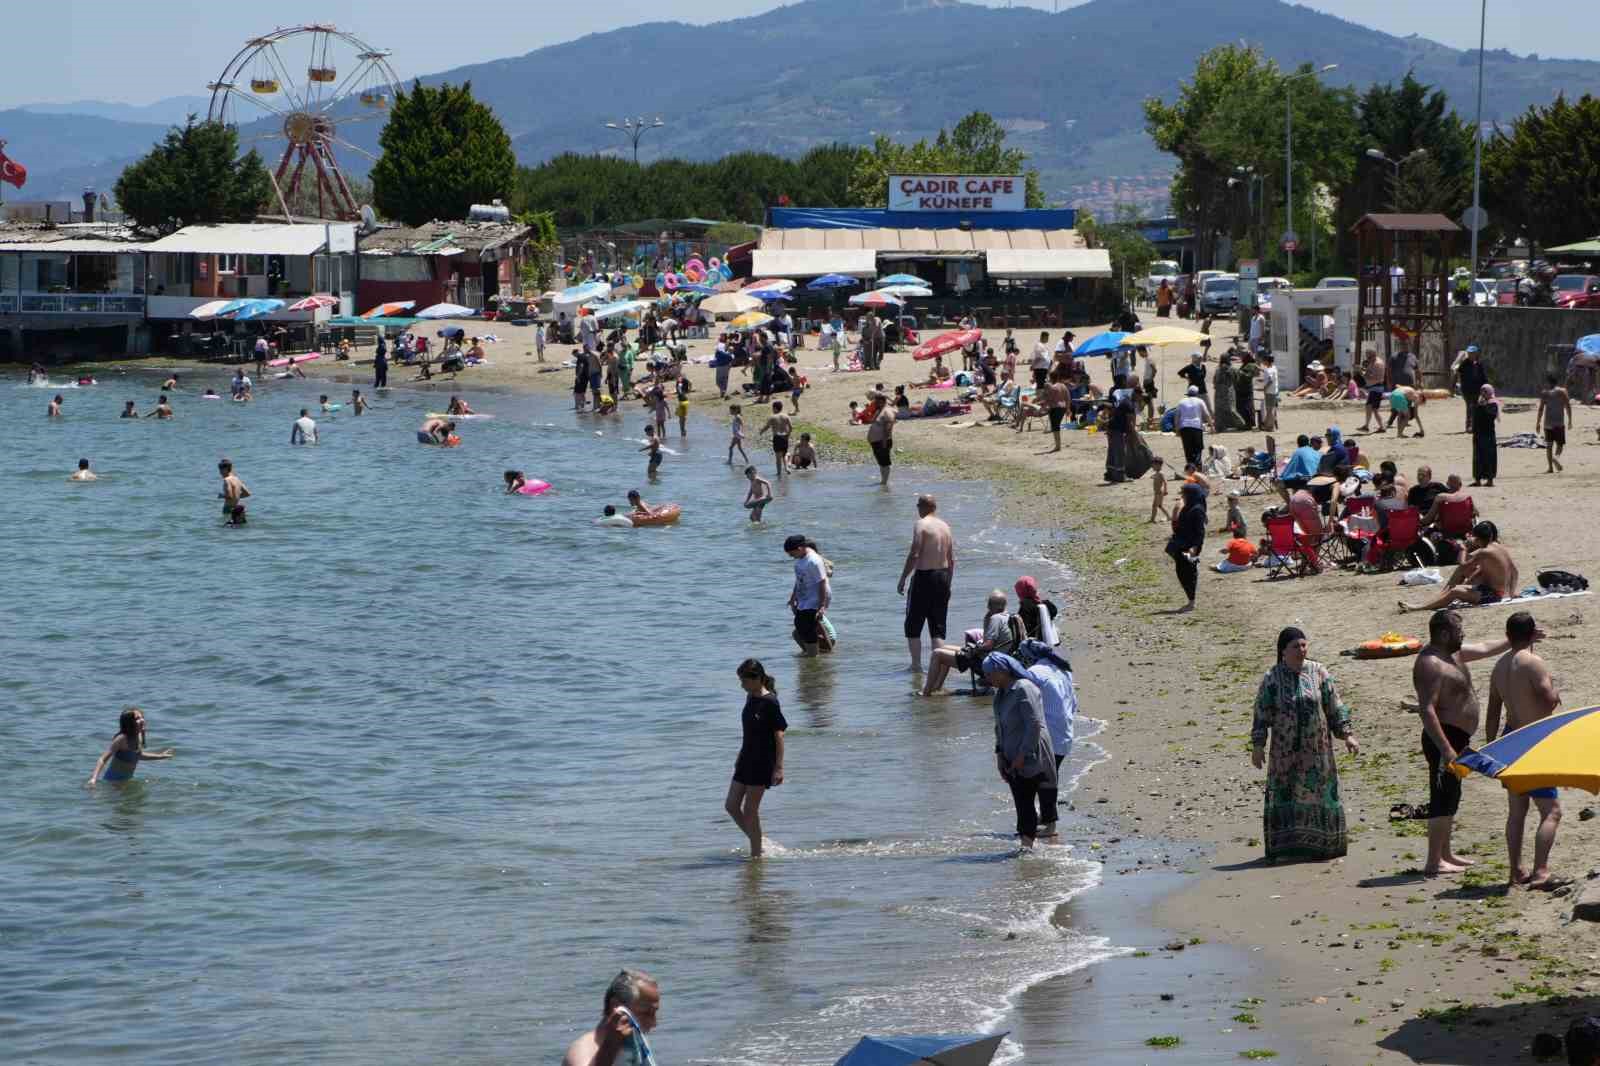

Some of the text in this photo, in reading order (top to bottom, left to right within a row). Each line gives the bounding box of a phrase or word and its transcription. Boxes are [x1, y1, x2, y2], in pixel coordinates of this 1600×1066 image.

[901, 180, 1014, 197] ÇADIR CAFE
[919, 195, 993, 209] KÜNEFE
